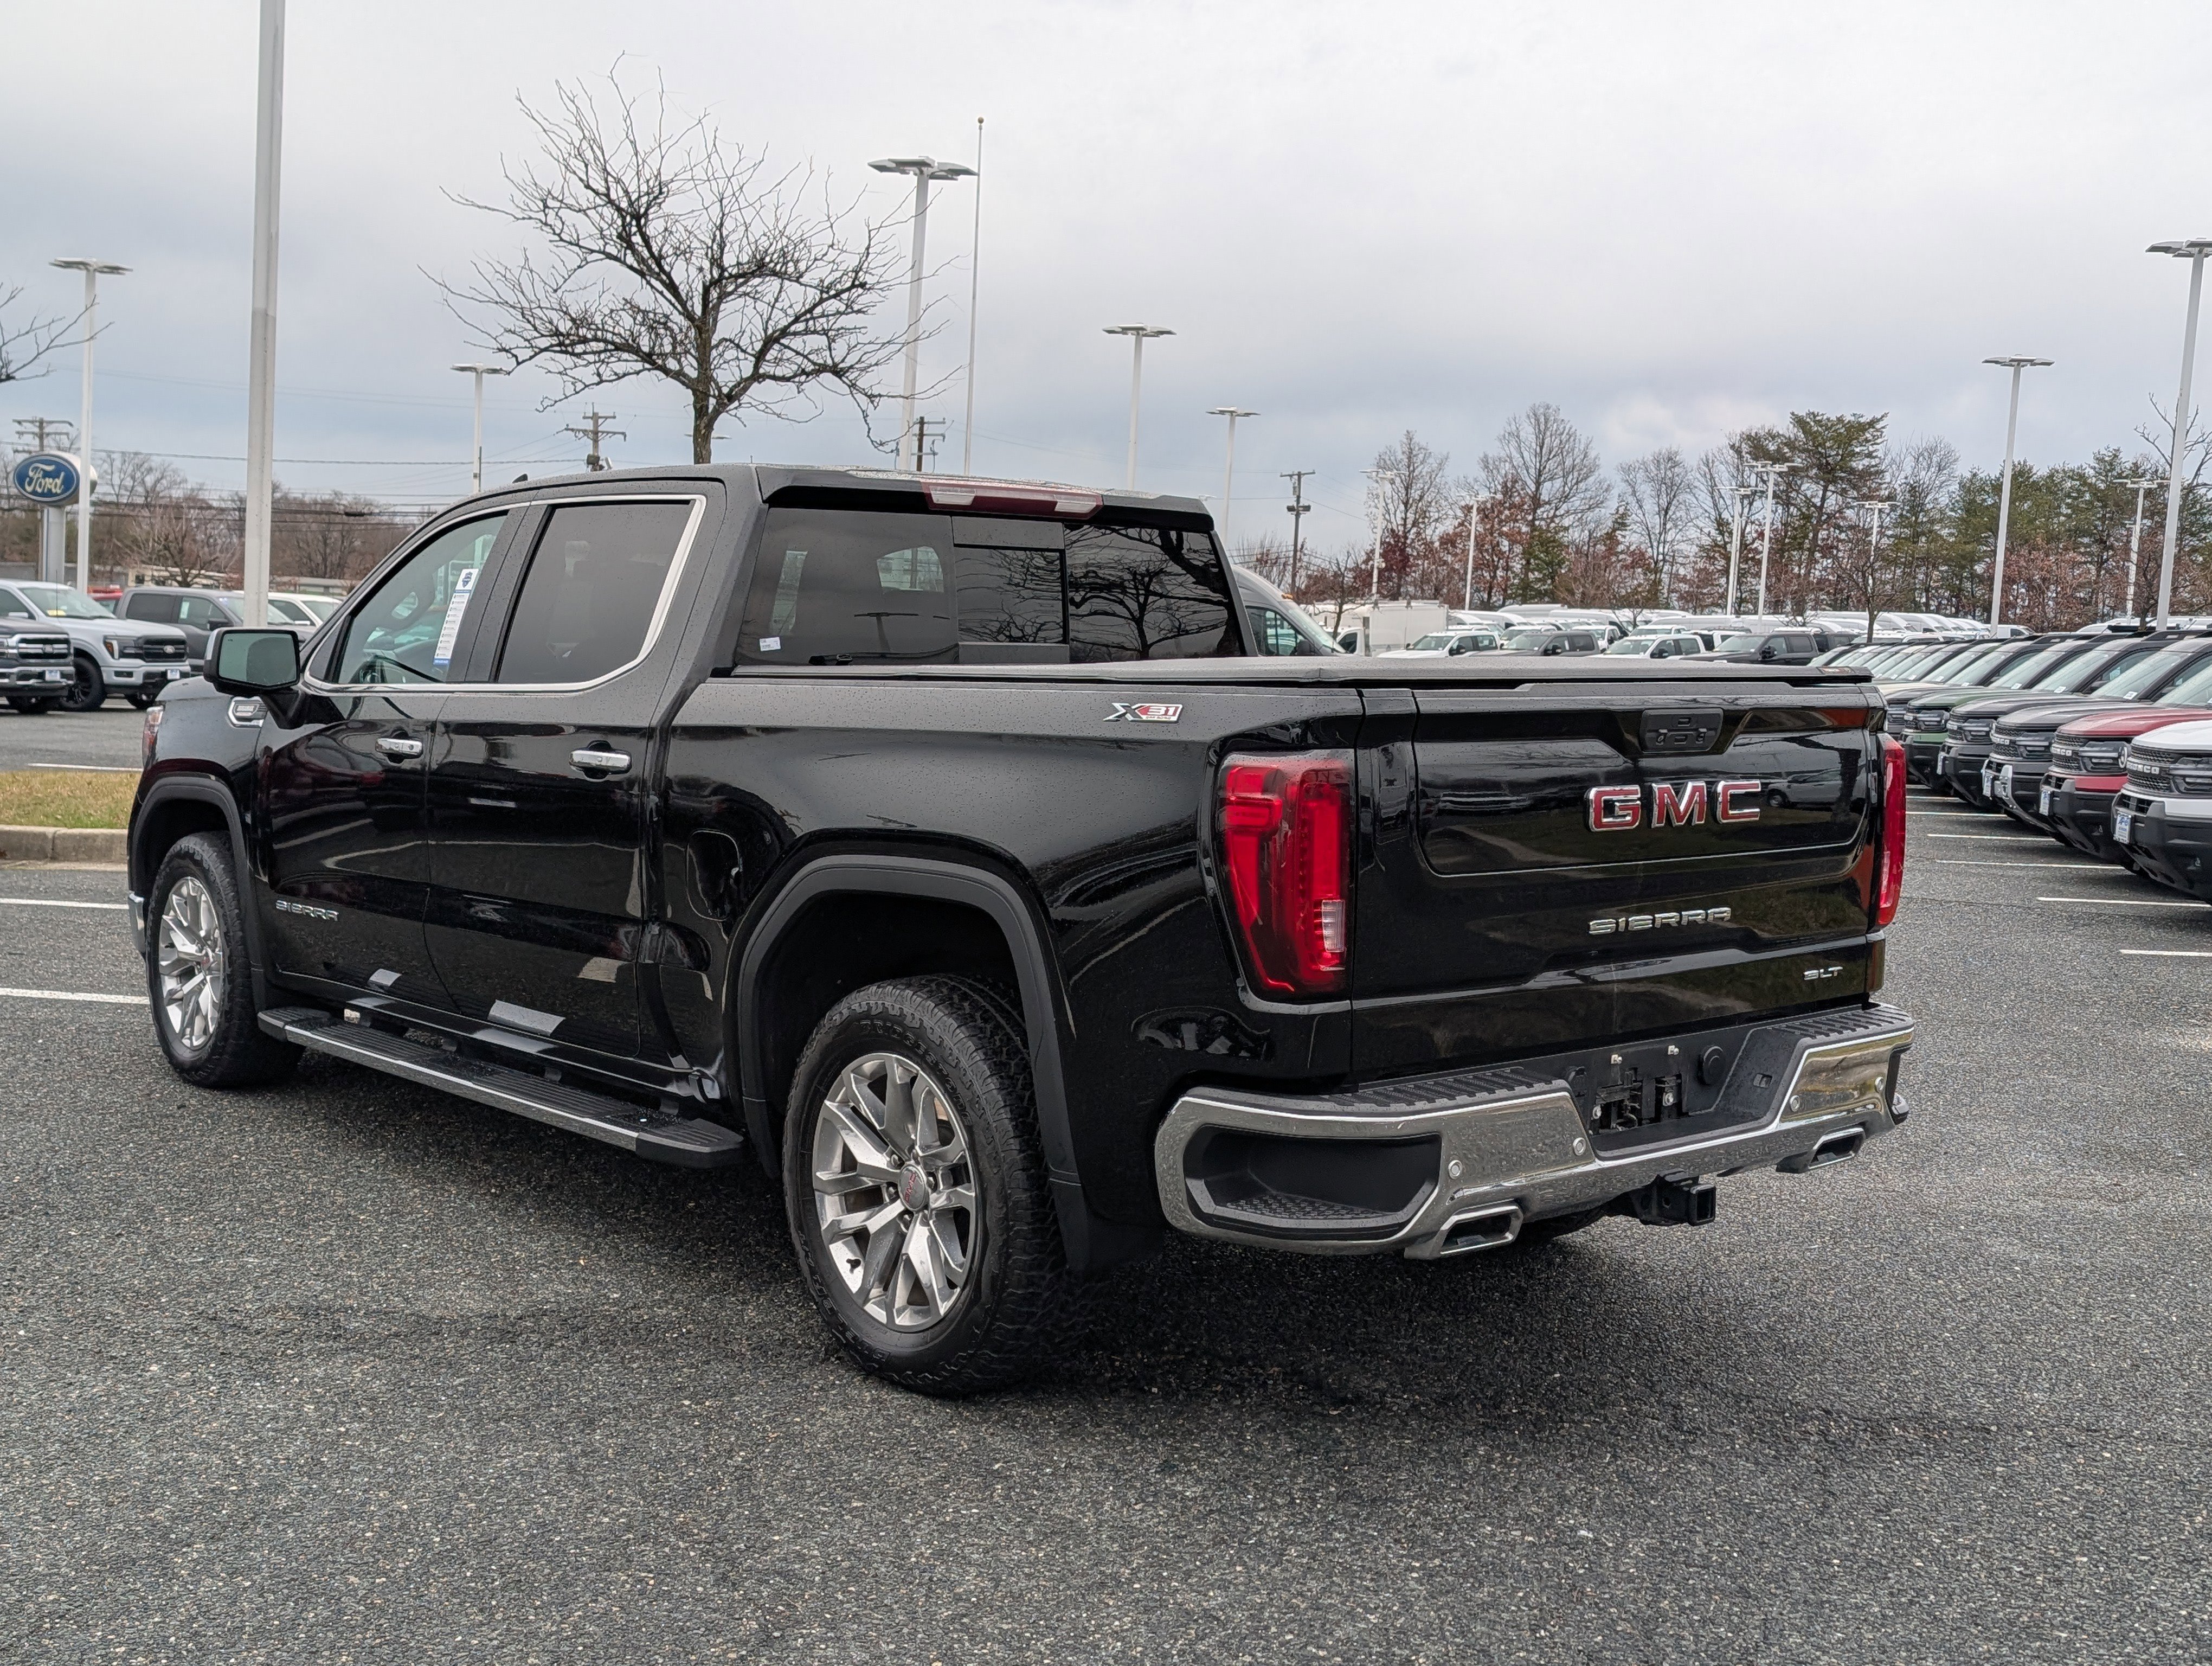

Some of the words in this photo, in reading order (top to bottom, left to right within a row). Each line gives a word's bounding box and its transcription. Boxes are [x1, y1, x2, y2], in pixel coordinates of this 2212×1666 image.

[25, 463, 65, 494] Ford
[1587, 779, 1761, 832] GMC
[275, 900, 339, 921] SIERRA
[1589, 907, 1732, 935] SIERRA
[1803, 966, 1843, 981] SLT
[860, 1019, 974, 1126] BRIDGESTONE
[904, 1172, 917, 1203] GMC
